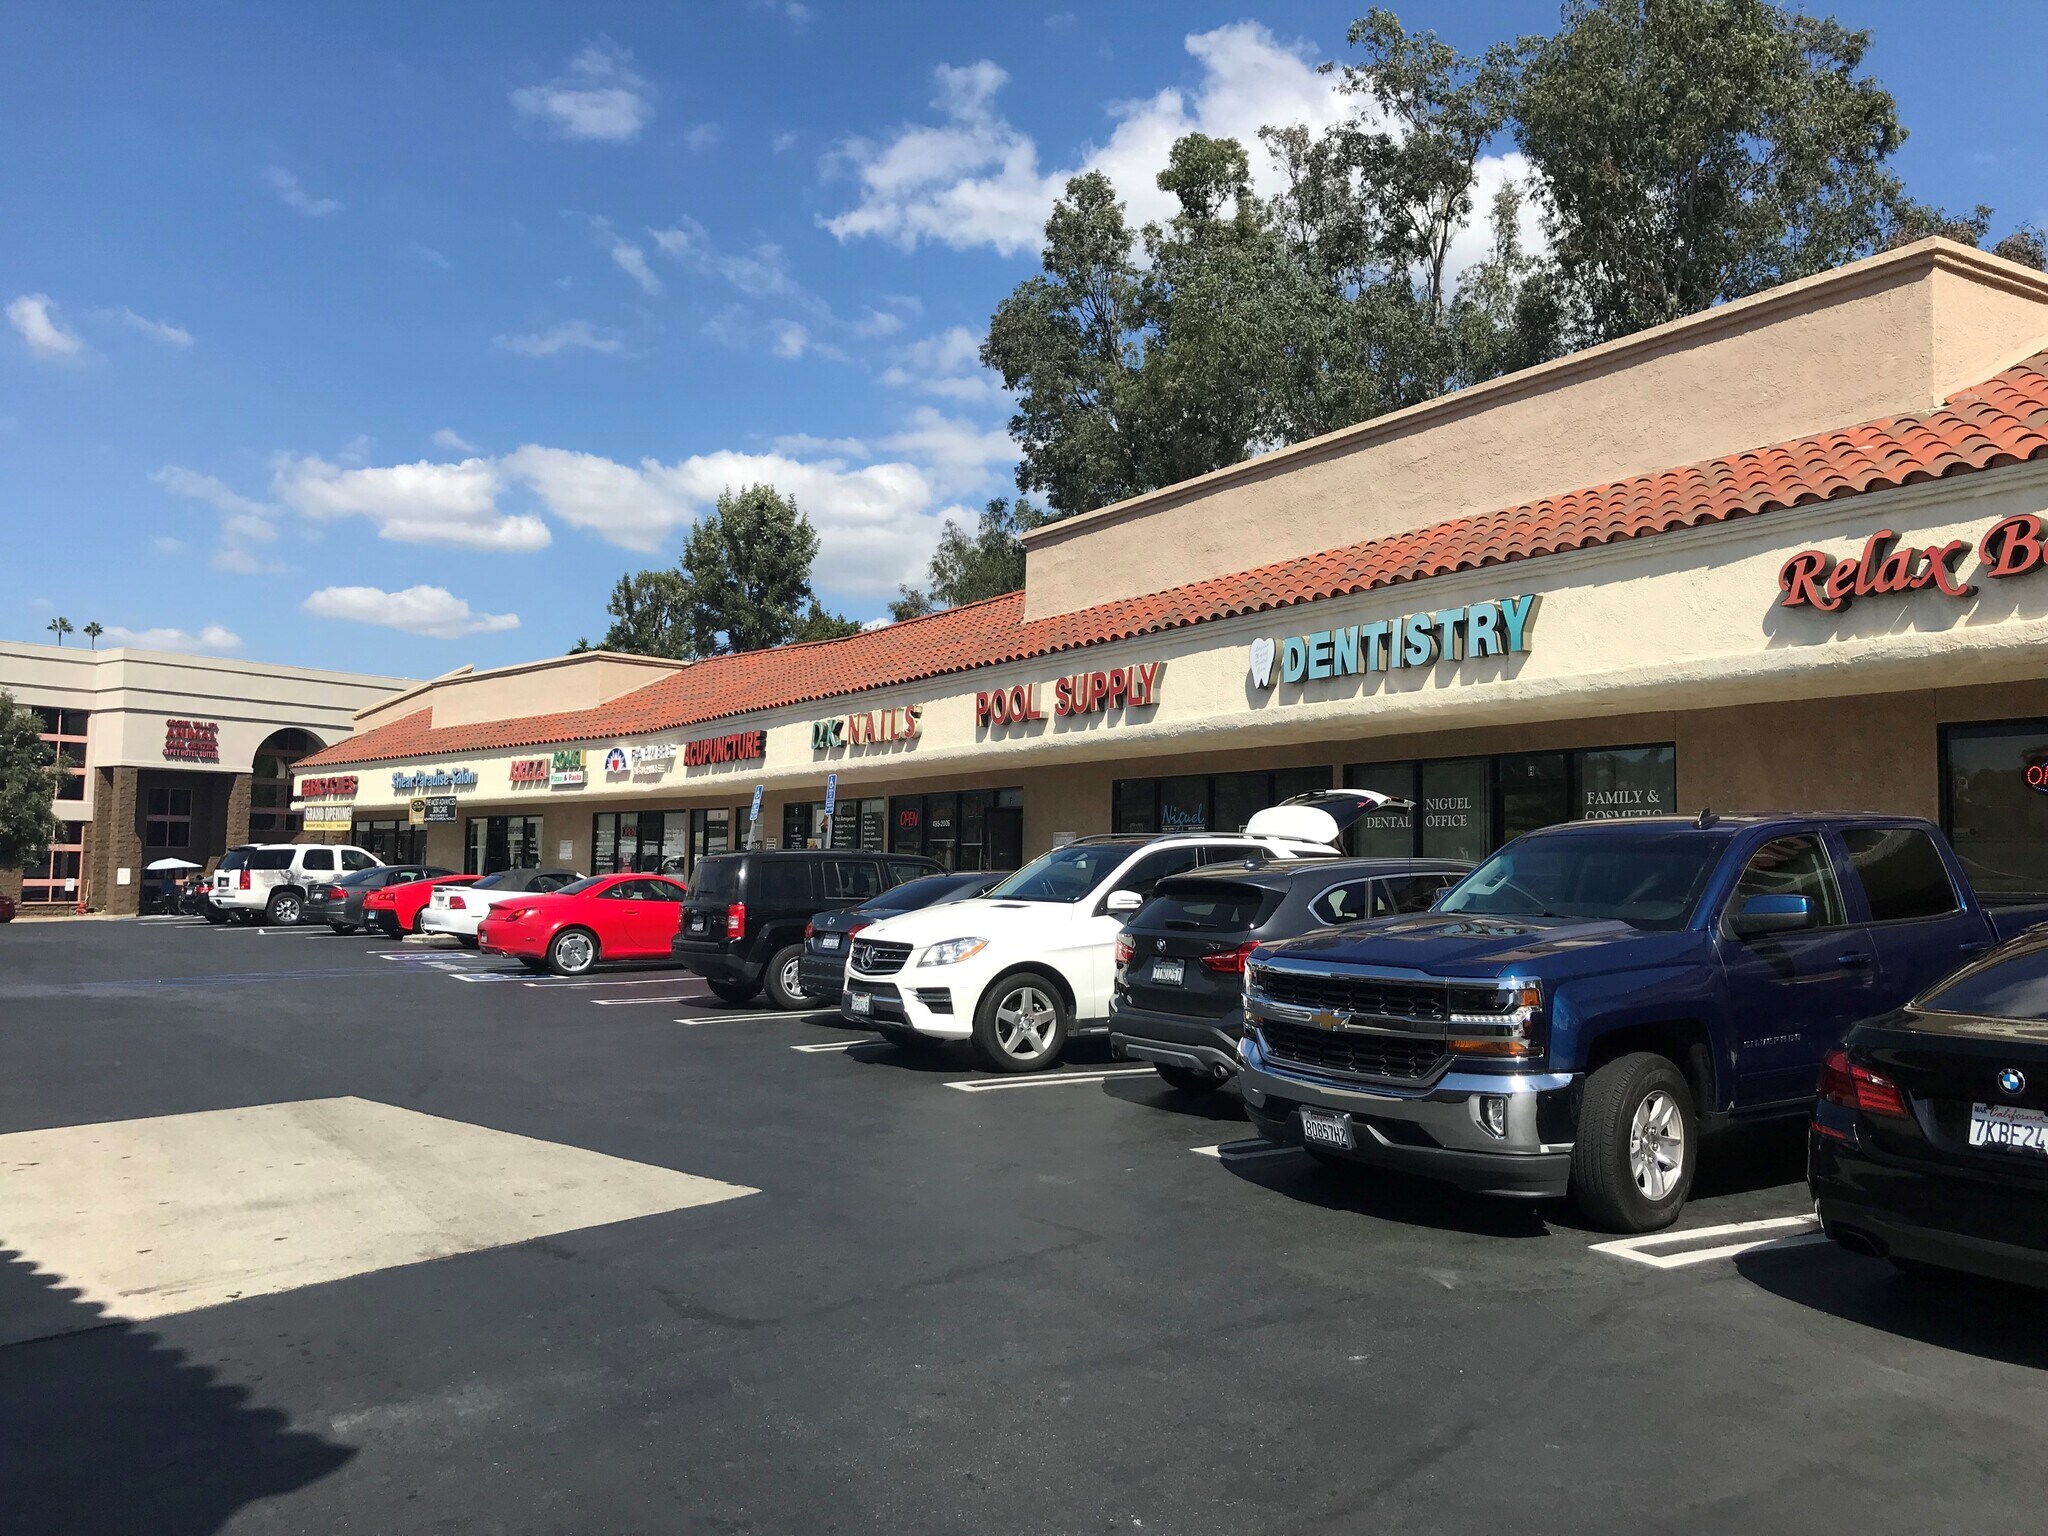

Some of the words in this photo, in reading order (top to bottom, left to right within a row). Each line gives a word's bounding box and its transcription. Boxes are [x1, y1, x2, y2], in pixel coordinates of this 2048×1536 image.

[1778, 528, 1968, 611] Relax
[1979, 513, 2048, 578] B
[1283, 594, 1536, 684] DENTISTRY
[976, 683, 1042, 727] POOL
[1055, 661, 1159, 716] SUPPLY
[848, 704, 916, 745] NAILS
[167, 728, 216, 741] ANIMAL
[181, 749, 198, 757] HOTEL
[632, 745, 671, 762] FARMERS
[683, 730, 762, 767] ACUPUNCTURE
[392, 772, 415, 788] Shear
[415, 770, 449, 787] Paradise
[451, 768, 475, 785] Salon
[509, 760, 547, 781] BELLA
[569, 773, 582, 781] Pasta
[311, 776, 356, 797] BICYCLES
[1426, 798, 1471, 810] NIGUEL
[1587, 790, 1643, 805] FAMILY
[1647, 789, 1660, 803] &
[306, 807, 325, 820] GRAND
[325, 806, 352, 821] OPENING!
[901, 811, 919, 827] OPEN
[1162, 803, 1205, 833] Niguel
[1367, 816, 1411, 828] DENTAL
[1425, 815, 1468, 827] OFFICE
[932, 819, 950, 828] 495-2006
[1989, 1106, 2048, 1123] California
